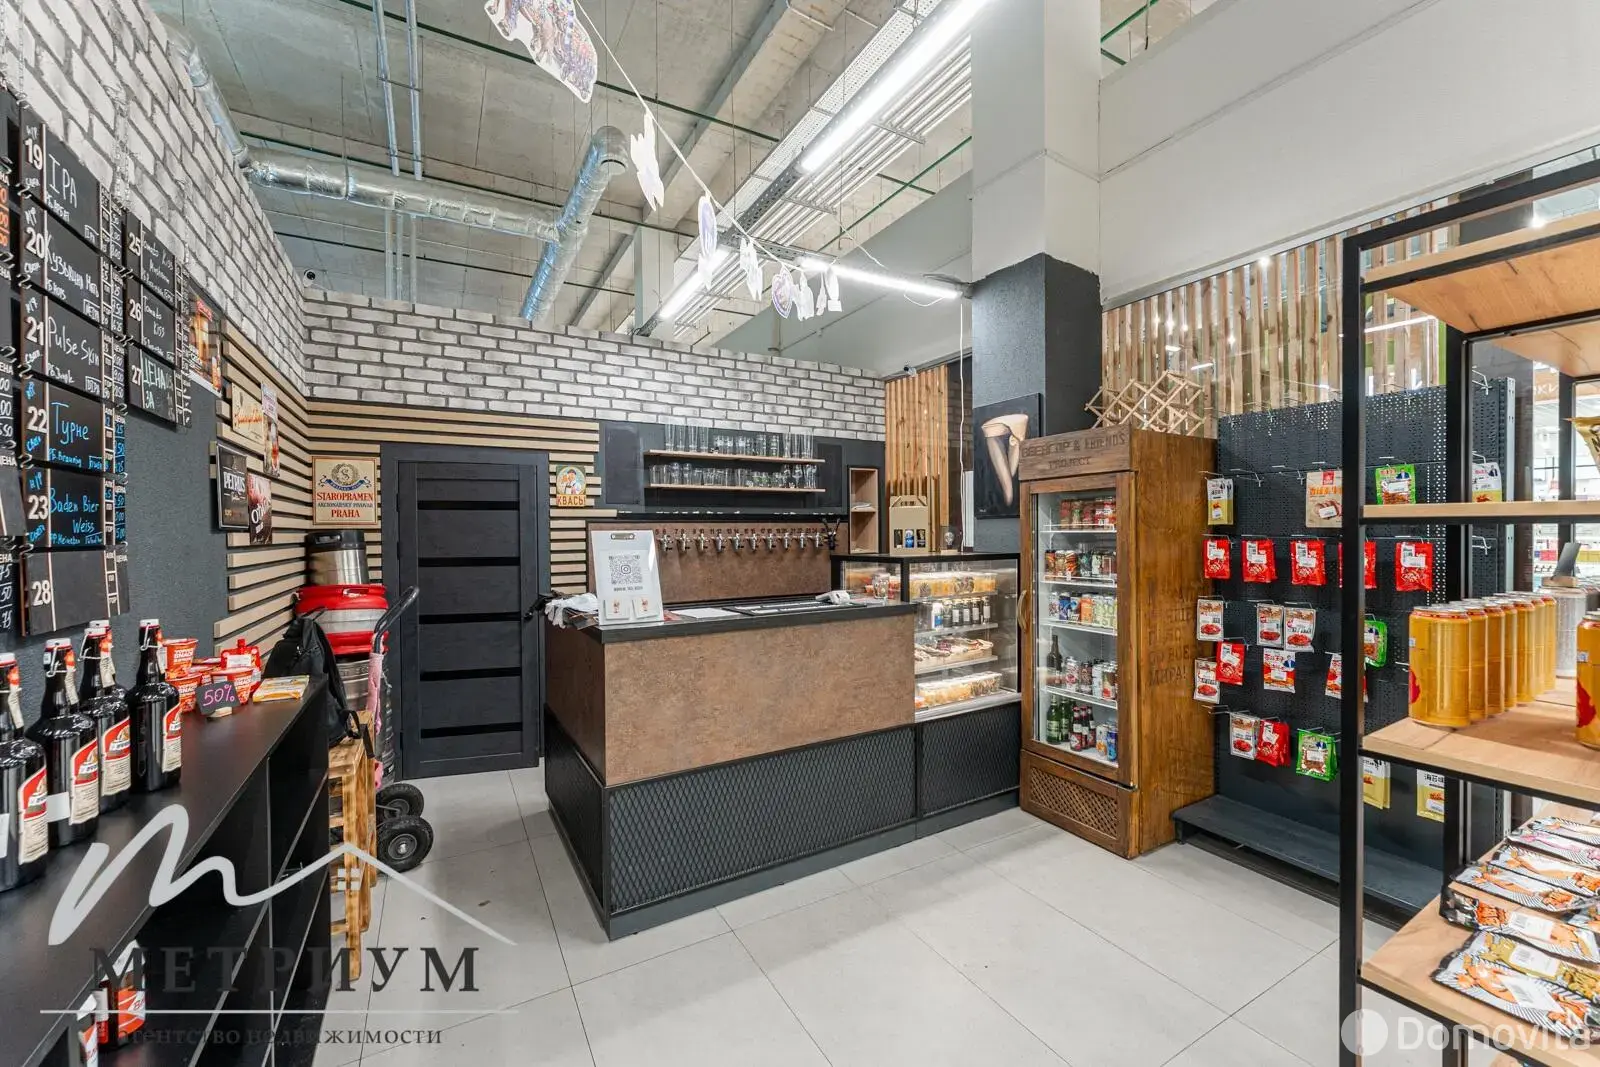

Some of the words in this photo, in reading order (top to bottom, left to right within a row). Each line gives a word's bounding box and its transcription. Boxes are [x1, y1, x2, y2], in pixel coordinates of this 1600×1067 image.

[25, 137, 43, 170] 19
[48, 153, 78, 208] IPA
[26, 226, 45, 259] 20
[129, 231, 141, 256] 25
[129, 298, 142, 322] 26
[26, 316, 44, 346] 21
[48, 316, 79, 355] Pulse
[131, 364, 142, 386] 27
[143, 357, 167, 390] ЦЕНА
[27, 406, 48, 434] 22
[51, 402, 89, 445] Турне
[27, 494, 48, 520] 23
[49, 487, 79, 513] Baden
[82, 494, 100, 513] Bier
[316, 492, 373, 501] STAROPRAMEN
[72, 517, 96, 533] Weiss
[331, 509, 361, 518] PRAHA
[32, 580, 51, 607] 28
[202, 684, 236, 707] 50%
